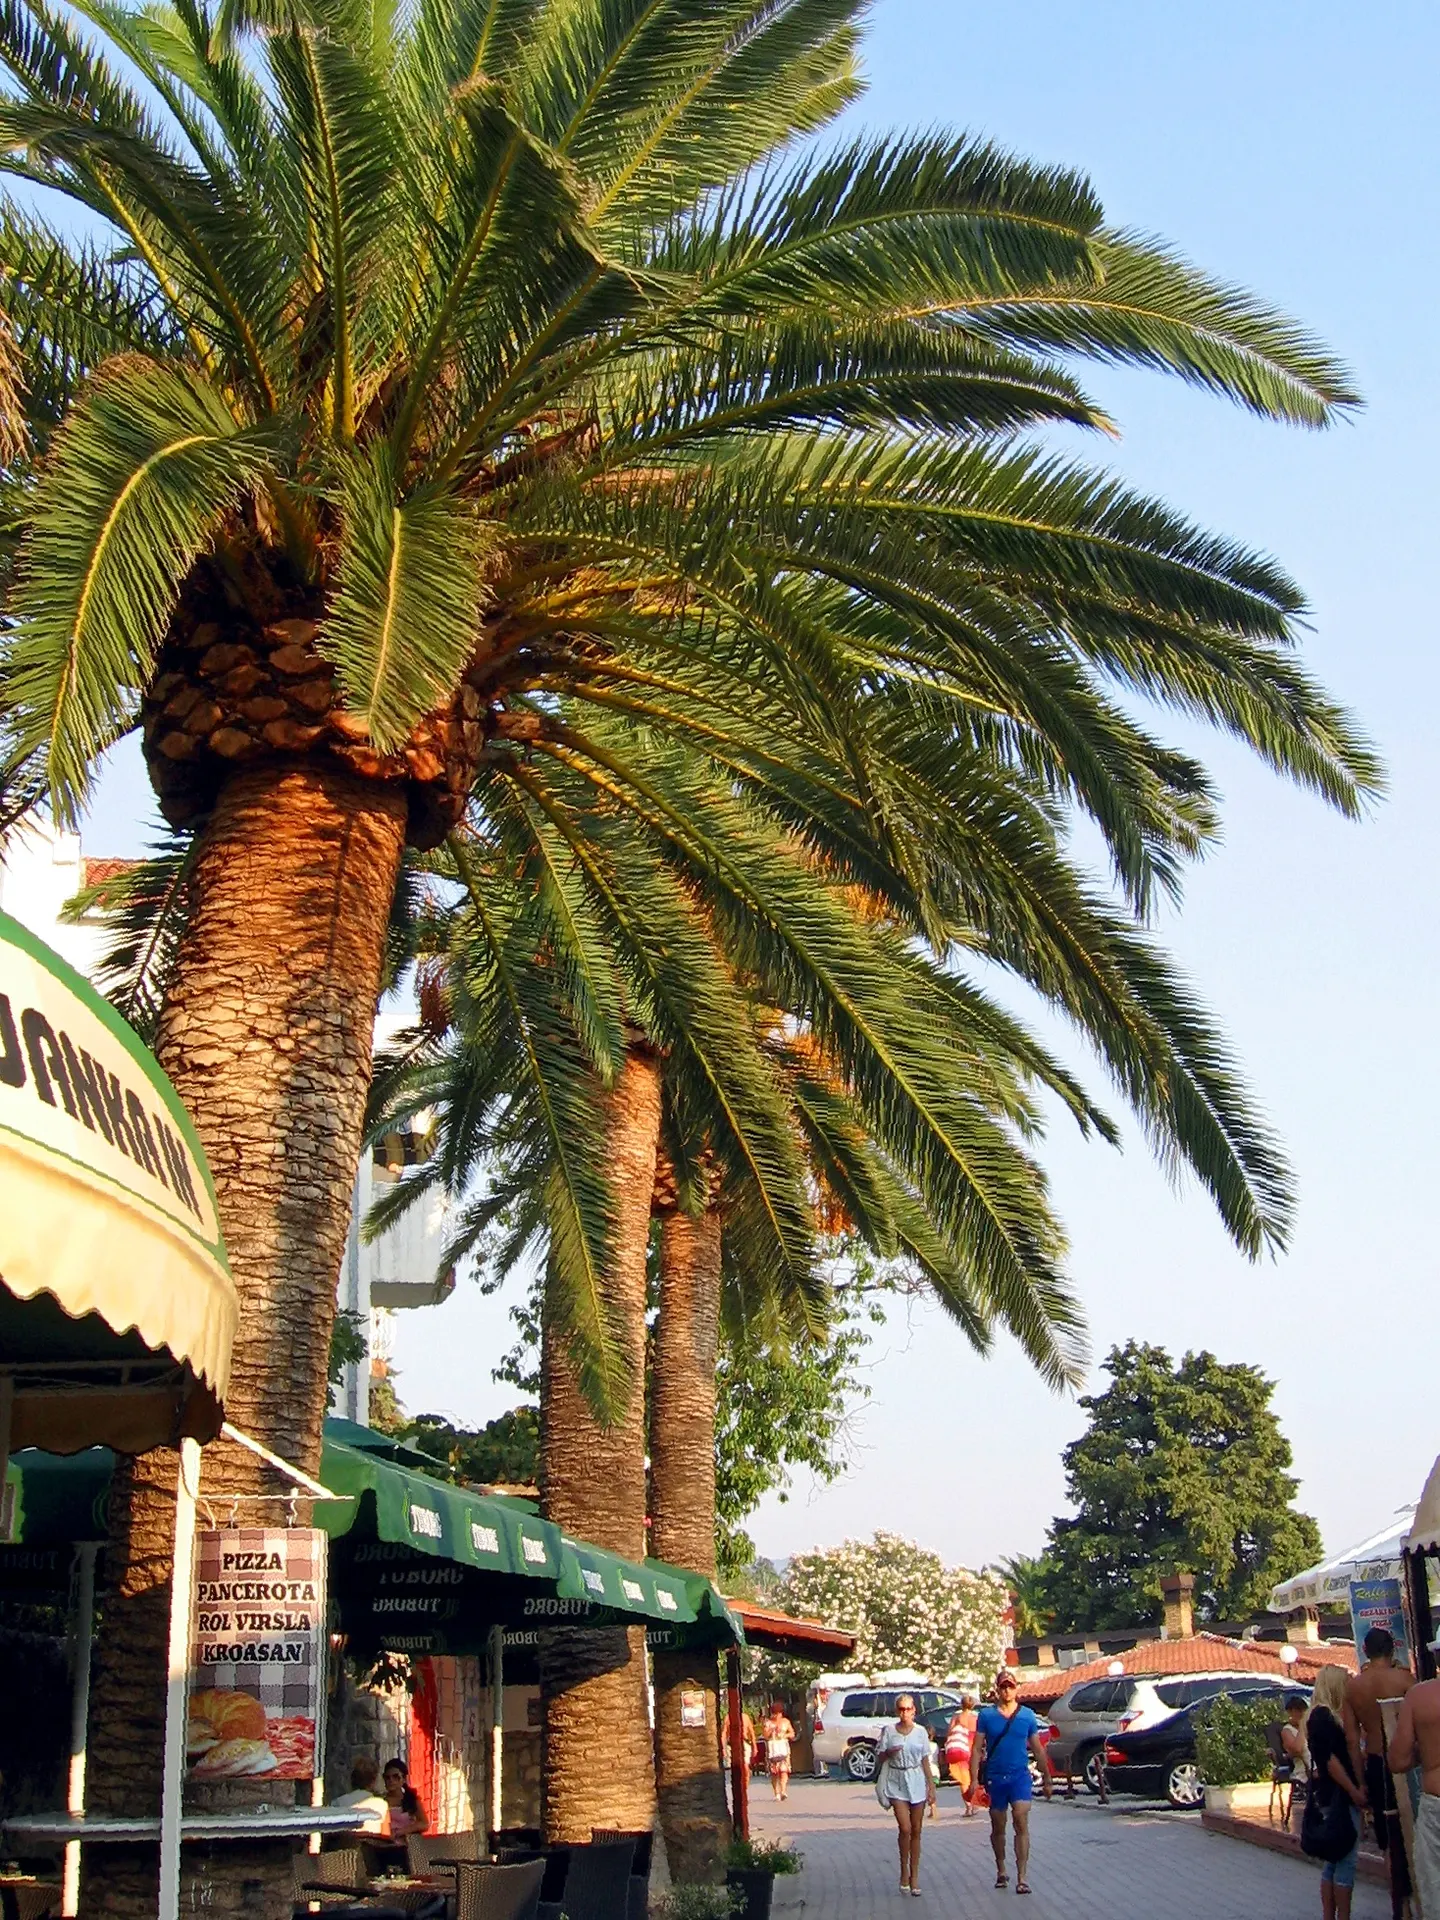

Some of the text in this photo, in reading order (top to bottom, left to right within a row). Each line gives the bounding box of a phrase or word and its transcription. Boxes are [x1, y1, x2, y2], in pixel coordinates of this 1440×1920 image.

[223, 1552, 282, 1571] PIZZA
[197, 1583, 315, 1601] PANCEROTA
[199, 1613, 311, 1632] ROL VIRSLA
[203, 1643, 302, 1662] KROASAN
